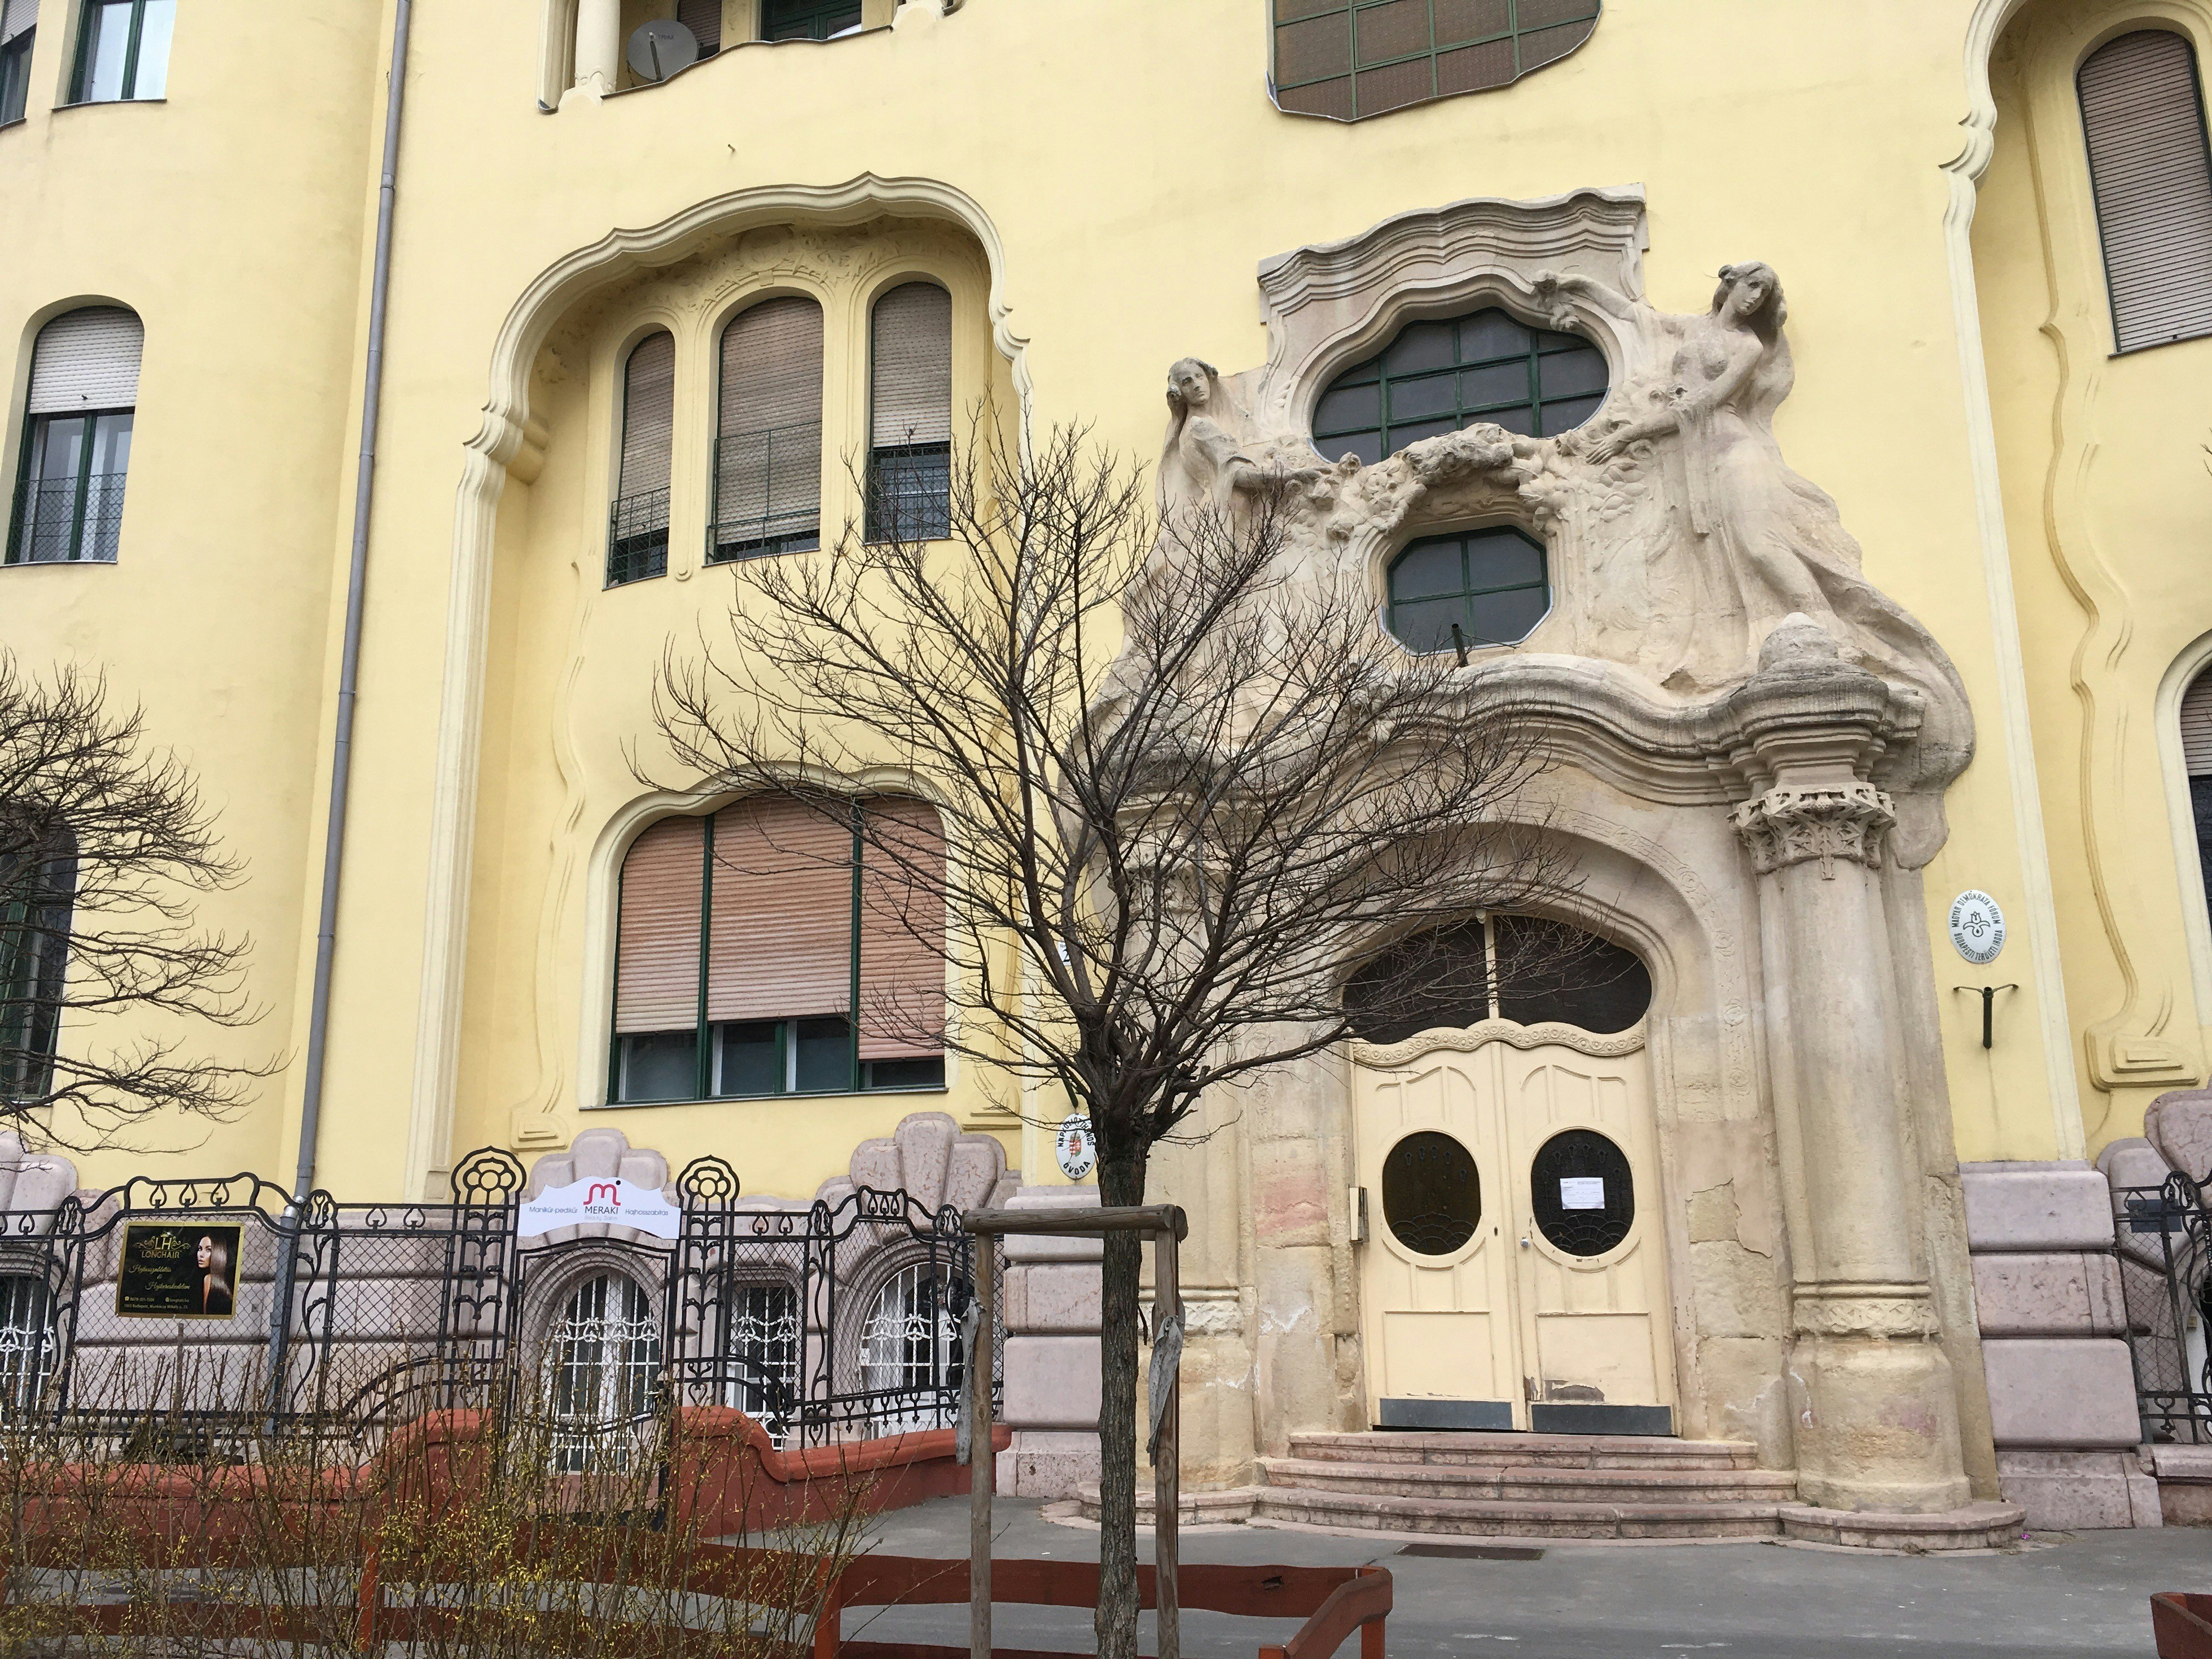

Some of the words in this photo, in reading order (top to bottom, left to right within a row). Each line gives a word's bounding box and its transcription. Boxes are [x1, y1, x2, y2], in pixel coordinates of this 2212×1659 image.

[1951, 906, 1961, 927] MAGYAR
[1957, 893, 1990, 906] DEMOKRATA
[1954, 933, 1976, 958] BUDAPESTI
[1993, 930, 2002, 946] IRODA
[585, 1206, 618, 1214] MERAKI
[155, 1237, 172, 1250] LH
